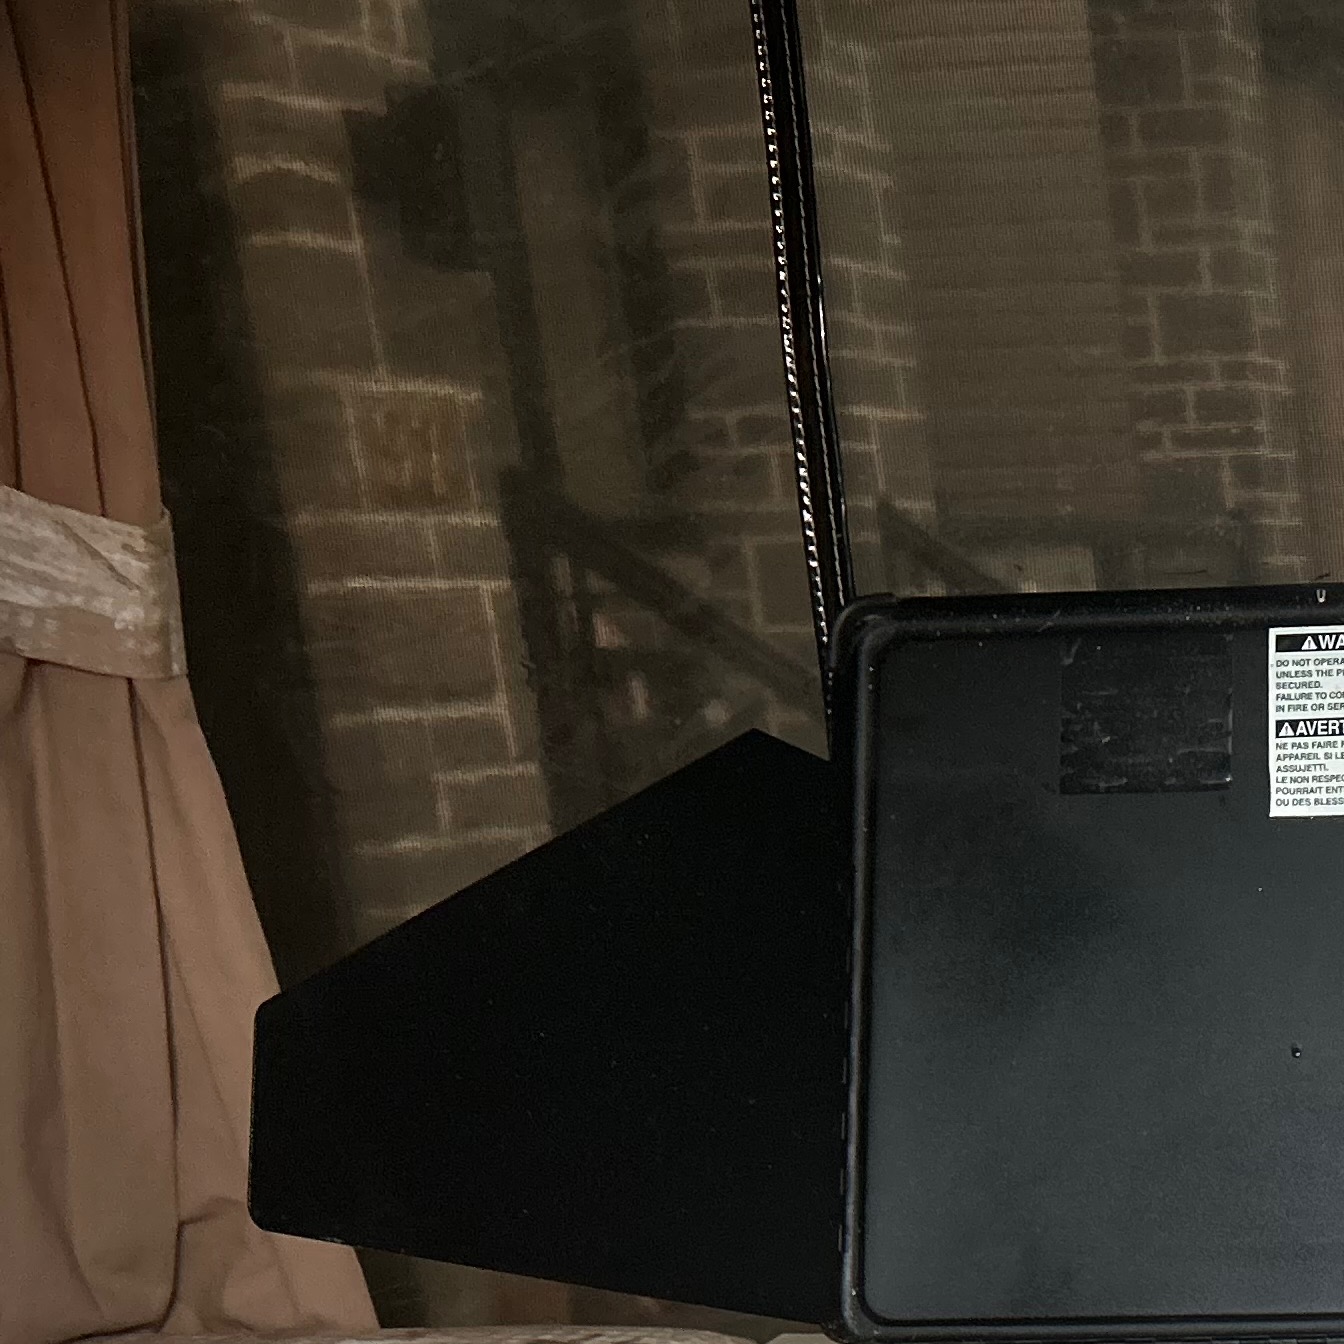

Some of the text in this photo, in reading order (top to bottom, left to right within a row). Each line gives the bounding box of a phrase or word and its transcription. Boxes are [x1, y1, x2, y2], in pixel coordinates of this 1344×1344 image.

[1275, 659, 1290, 668] DO
[1291, 658, 1311, 667] NOT
[1275, 669, 1313, 679] UNLESS
[1315, 669, 1334, 678] THE
[1275, 680, 1323, 690] SECURED.
[1275, 691, 1313, 701] FAILURE
[1314, 691, 1328, 700] TO
[1275, 704, 1285, 713] IN
[1287, 703, 1309, 712] FIRE
[1310, 702, 1325, 711] OR
[1275, 742, 1289, 751] NE
[1291, 741, 1309, 750] PAS
[1311, 740, 1339, 750] FAIRE
[1275, 752, 1321, 762] APPAREIL
[1323, 751, 1333, 760] SI
[1275, 775, 1288, 784] LE
[1289, 775, 1310, 784] NON
[1275, 786, 1324, 796] POURRAIT
[1275, 798, 1290, 807] OU
[1292, 798, 1312, 807] DES
